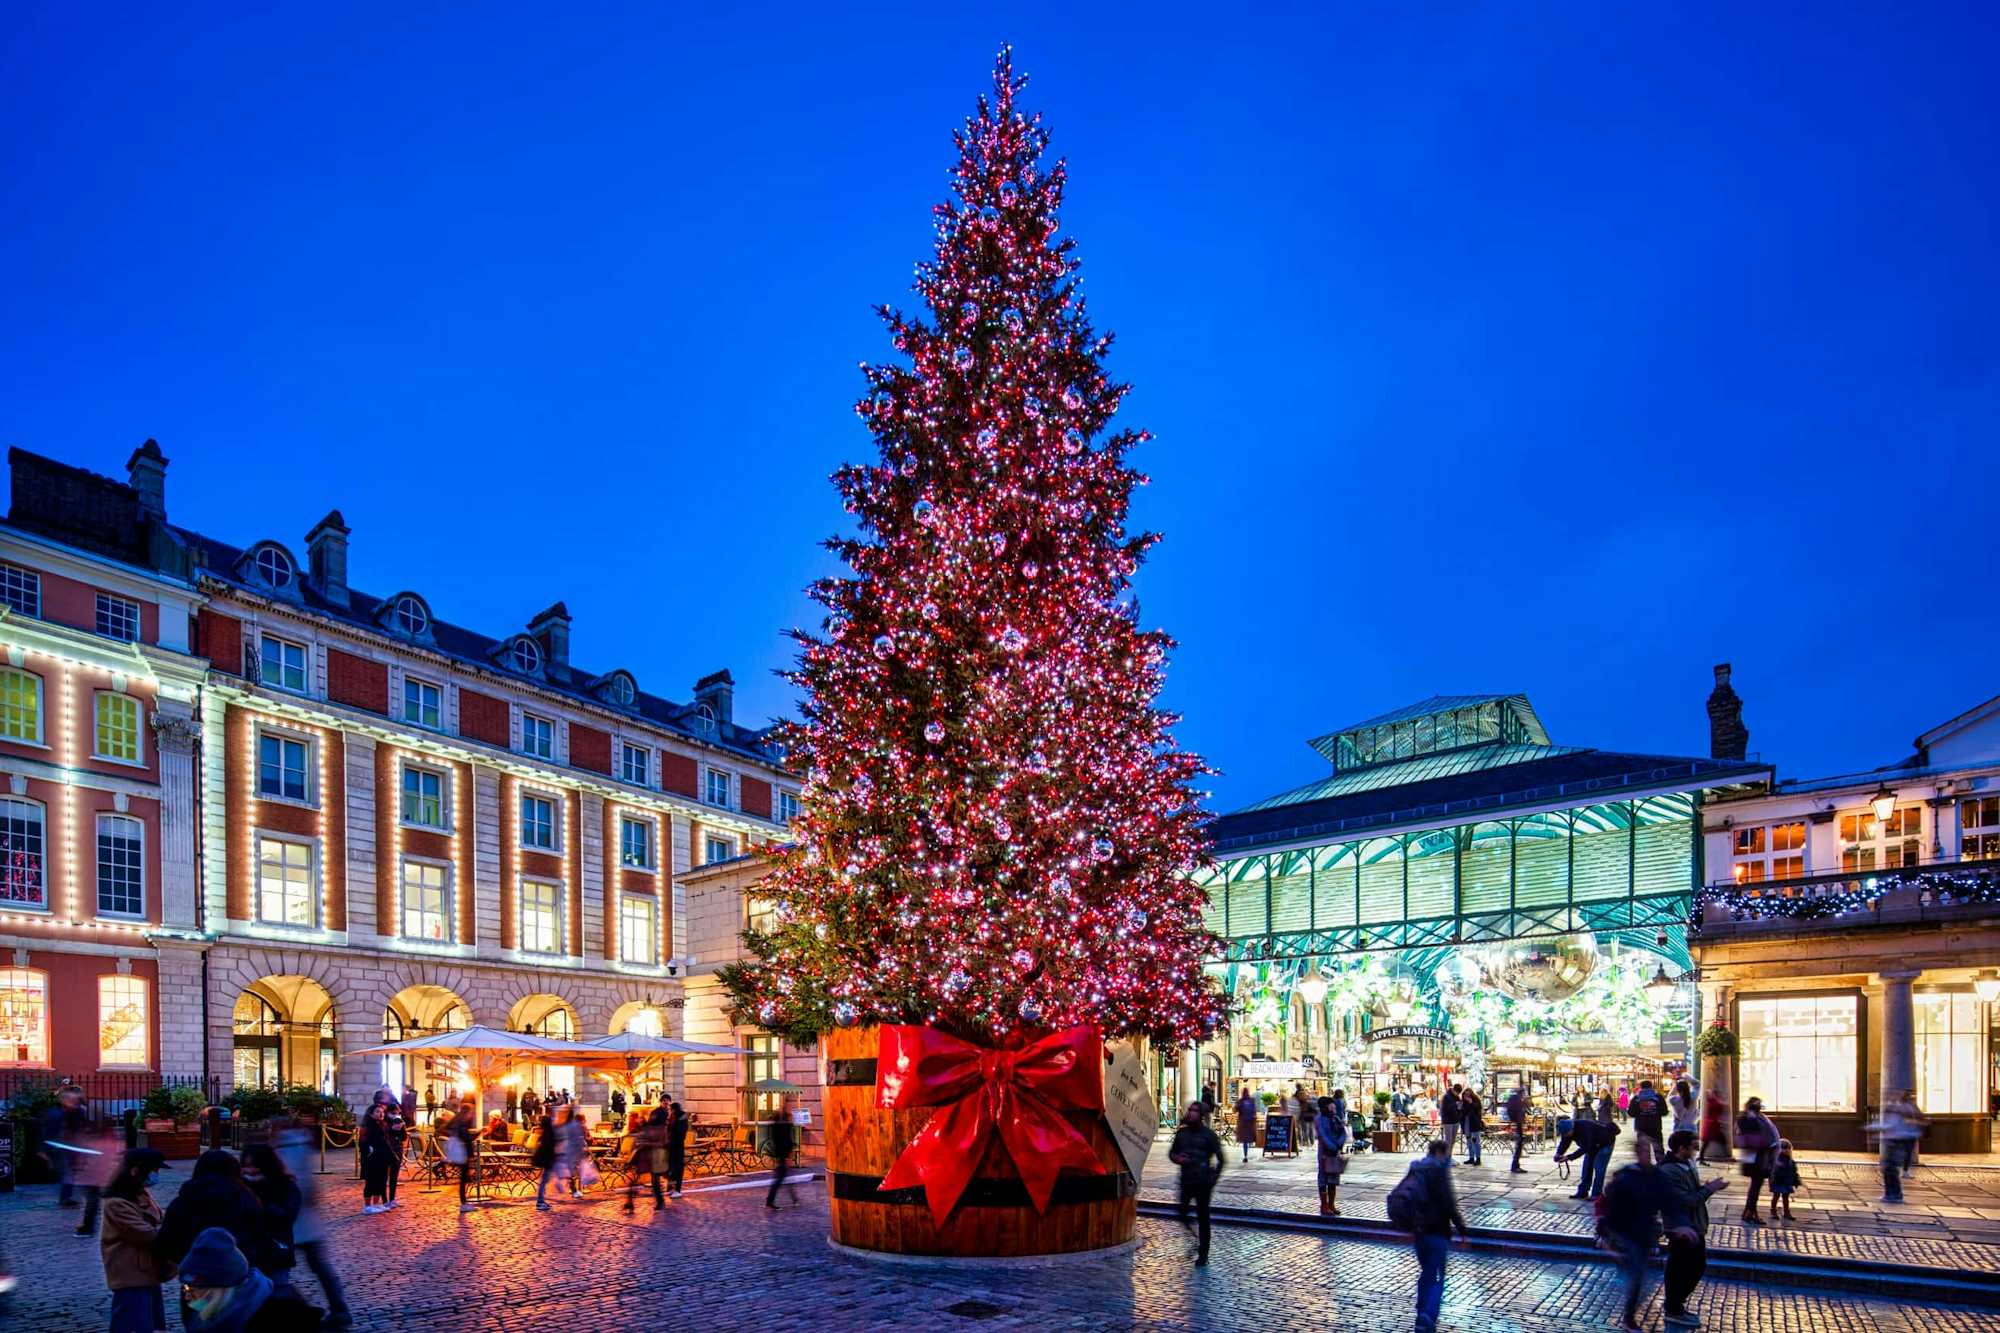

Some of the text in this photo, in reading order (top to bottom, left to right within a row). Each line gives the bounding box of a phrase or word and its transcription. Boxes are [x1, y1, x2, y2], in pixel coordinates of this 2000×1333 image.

[1372, 1027, 1442, 1040] APPLE MARKET
[1250, 1063, 1295, 1074] BEACH HOUSE
